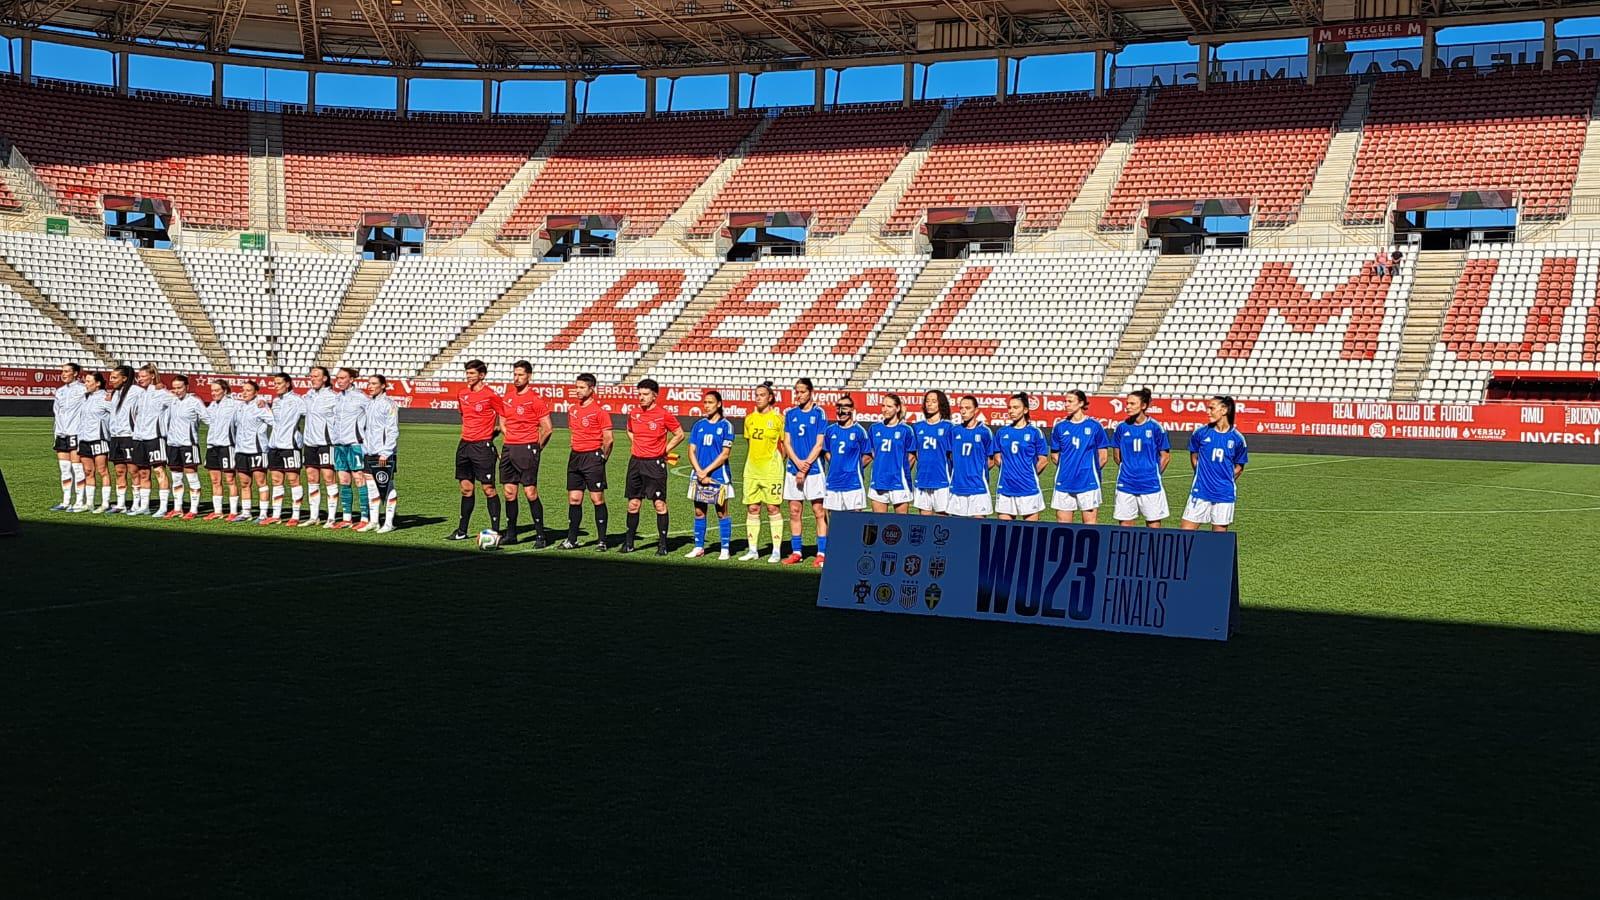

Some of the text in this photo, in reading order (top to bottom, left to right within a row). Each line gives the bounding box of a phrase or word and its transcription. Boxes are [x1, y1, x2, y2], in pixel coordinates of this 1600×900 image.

[1338, 24, 1402, 36] MESEGUER
[1275, 402, 1296, 418] RMU
[1332, 403, 1354, 419] REAL
[1357, 404, 1393, 420] MURCIA
[1396, 404, 1420, 421] CLUB
[1423, 405, 1436, 421] DE
[1520, 407, 1544, 423] RMU
[798, 424, 805, 436] 5
[1264, 423, 1297, 431] VERSUS
[1311, 423, 1364, 436] FEDERACIÓN
[1402, 425, 1458, 438] FEDERACIÓN
[1471, 428, 1507, 436] VERSUS
[703, 434, 713, 446] 10
[752, 428, 764, 440] 22
[838, 441, 846, 454] 2
[881, 439, 892, 452] 21
[923, 436, 937, 449] 24
[1011, 441, 1019, 454] 6
[1071, 436, 1080, 449] 4
[1133, 438, 1142, 452] 11
[962, 443, 973, 456] 17
[1211, 447, 1224, 462] 19
[1106, 529, 1195, 581] FRIENDLY
[976, 523, 1100, 621] WU23
[1101, 577, 1168, 629] FINALS
